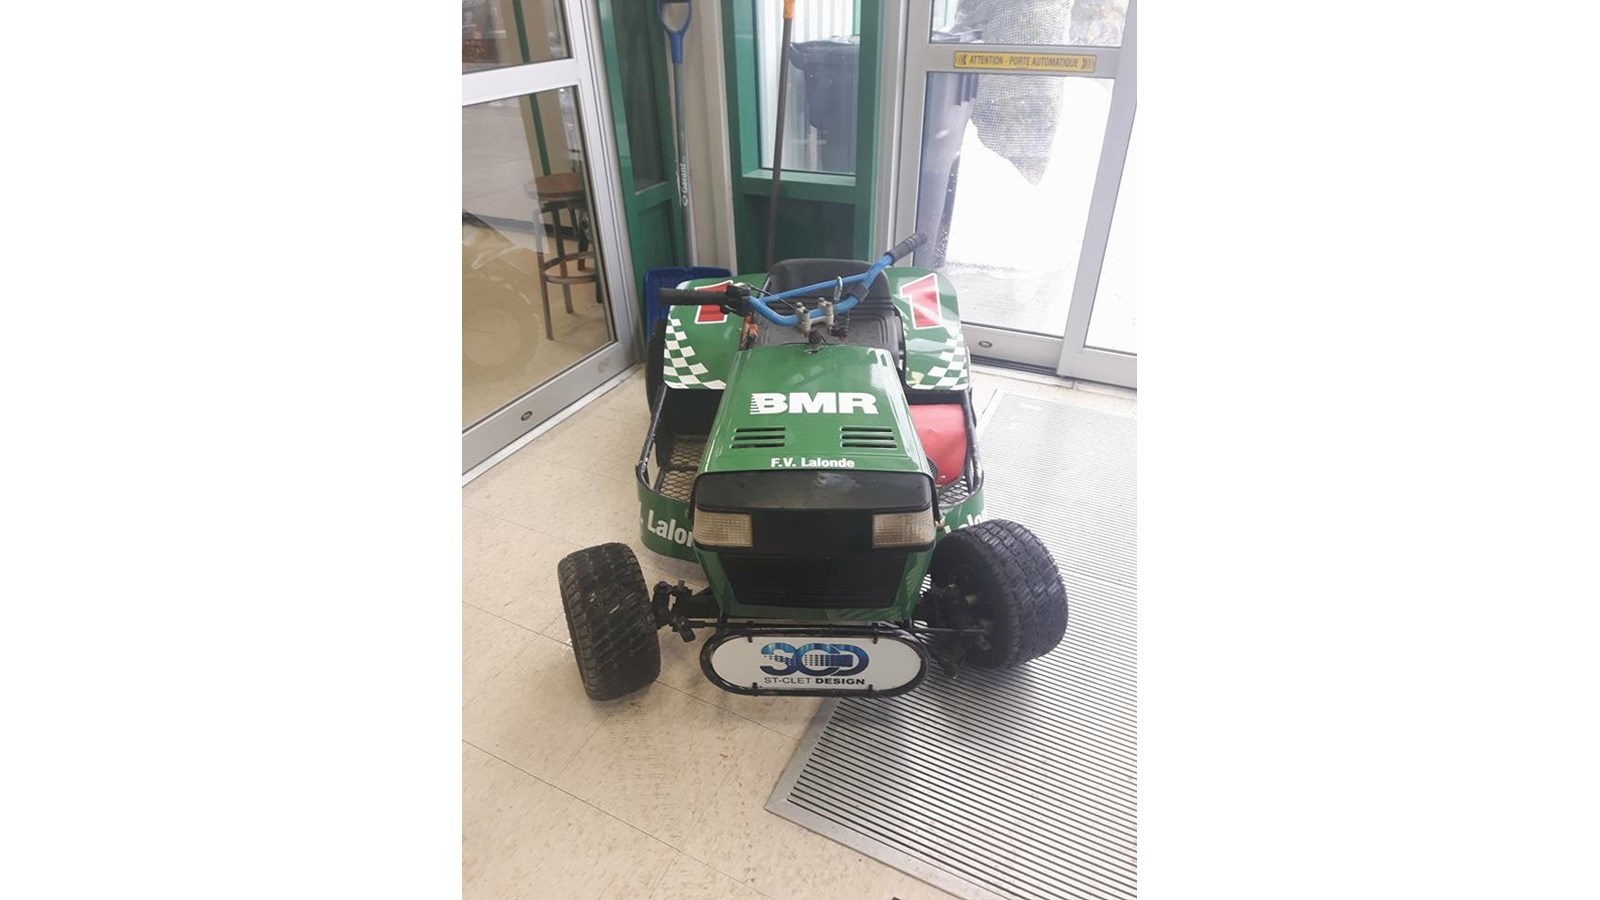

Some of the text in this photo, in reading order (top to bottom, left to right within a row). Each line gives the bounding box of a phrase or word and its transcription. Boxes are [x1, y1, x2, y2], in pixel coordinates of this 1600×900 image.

[969, 56, 1004, 66] ATTENTION
[1009, 57, 1030, 67] PORTE
[1031, 57, 1079, 69] AUTOMATIQUE
[900, 273, 943, 329] 1
[750, 392, 879, 415] BMR
[771, 457, 855, 469] F.V. Lalonde
[764, 676, 866, 686] ST-CLET DESIGN
